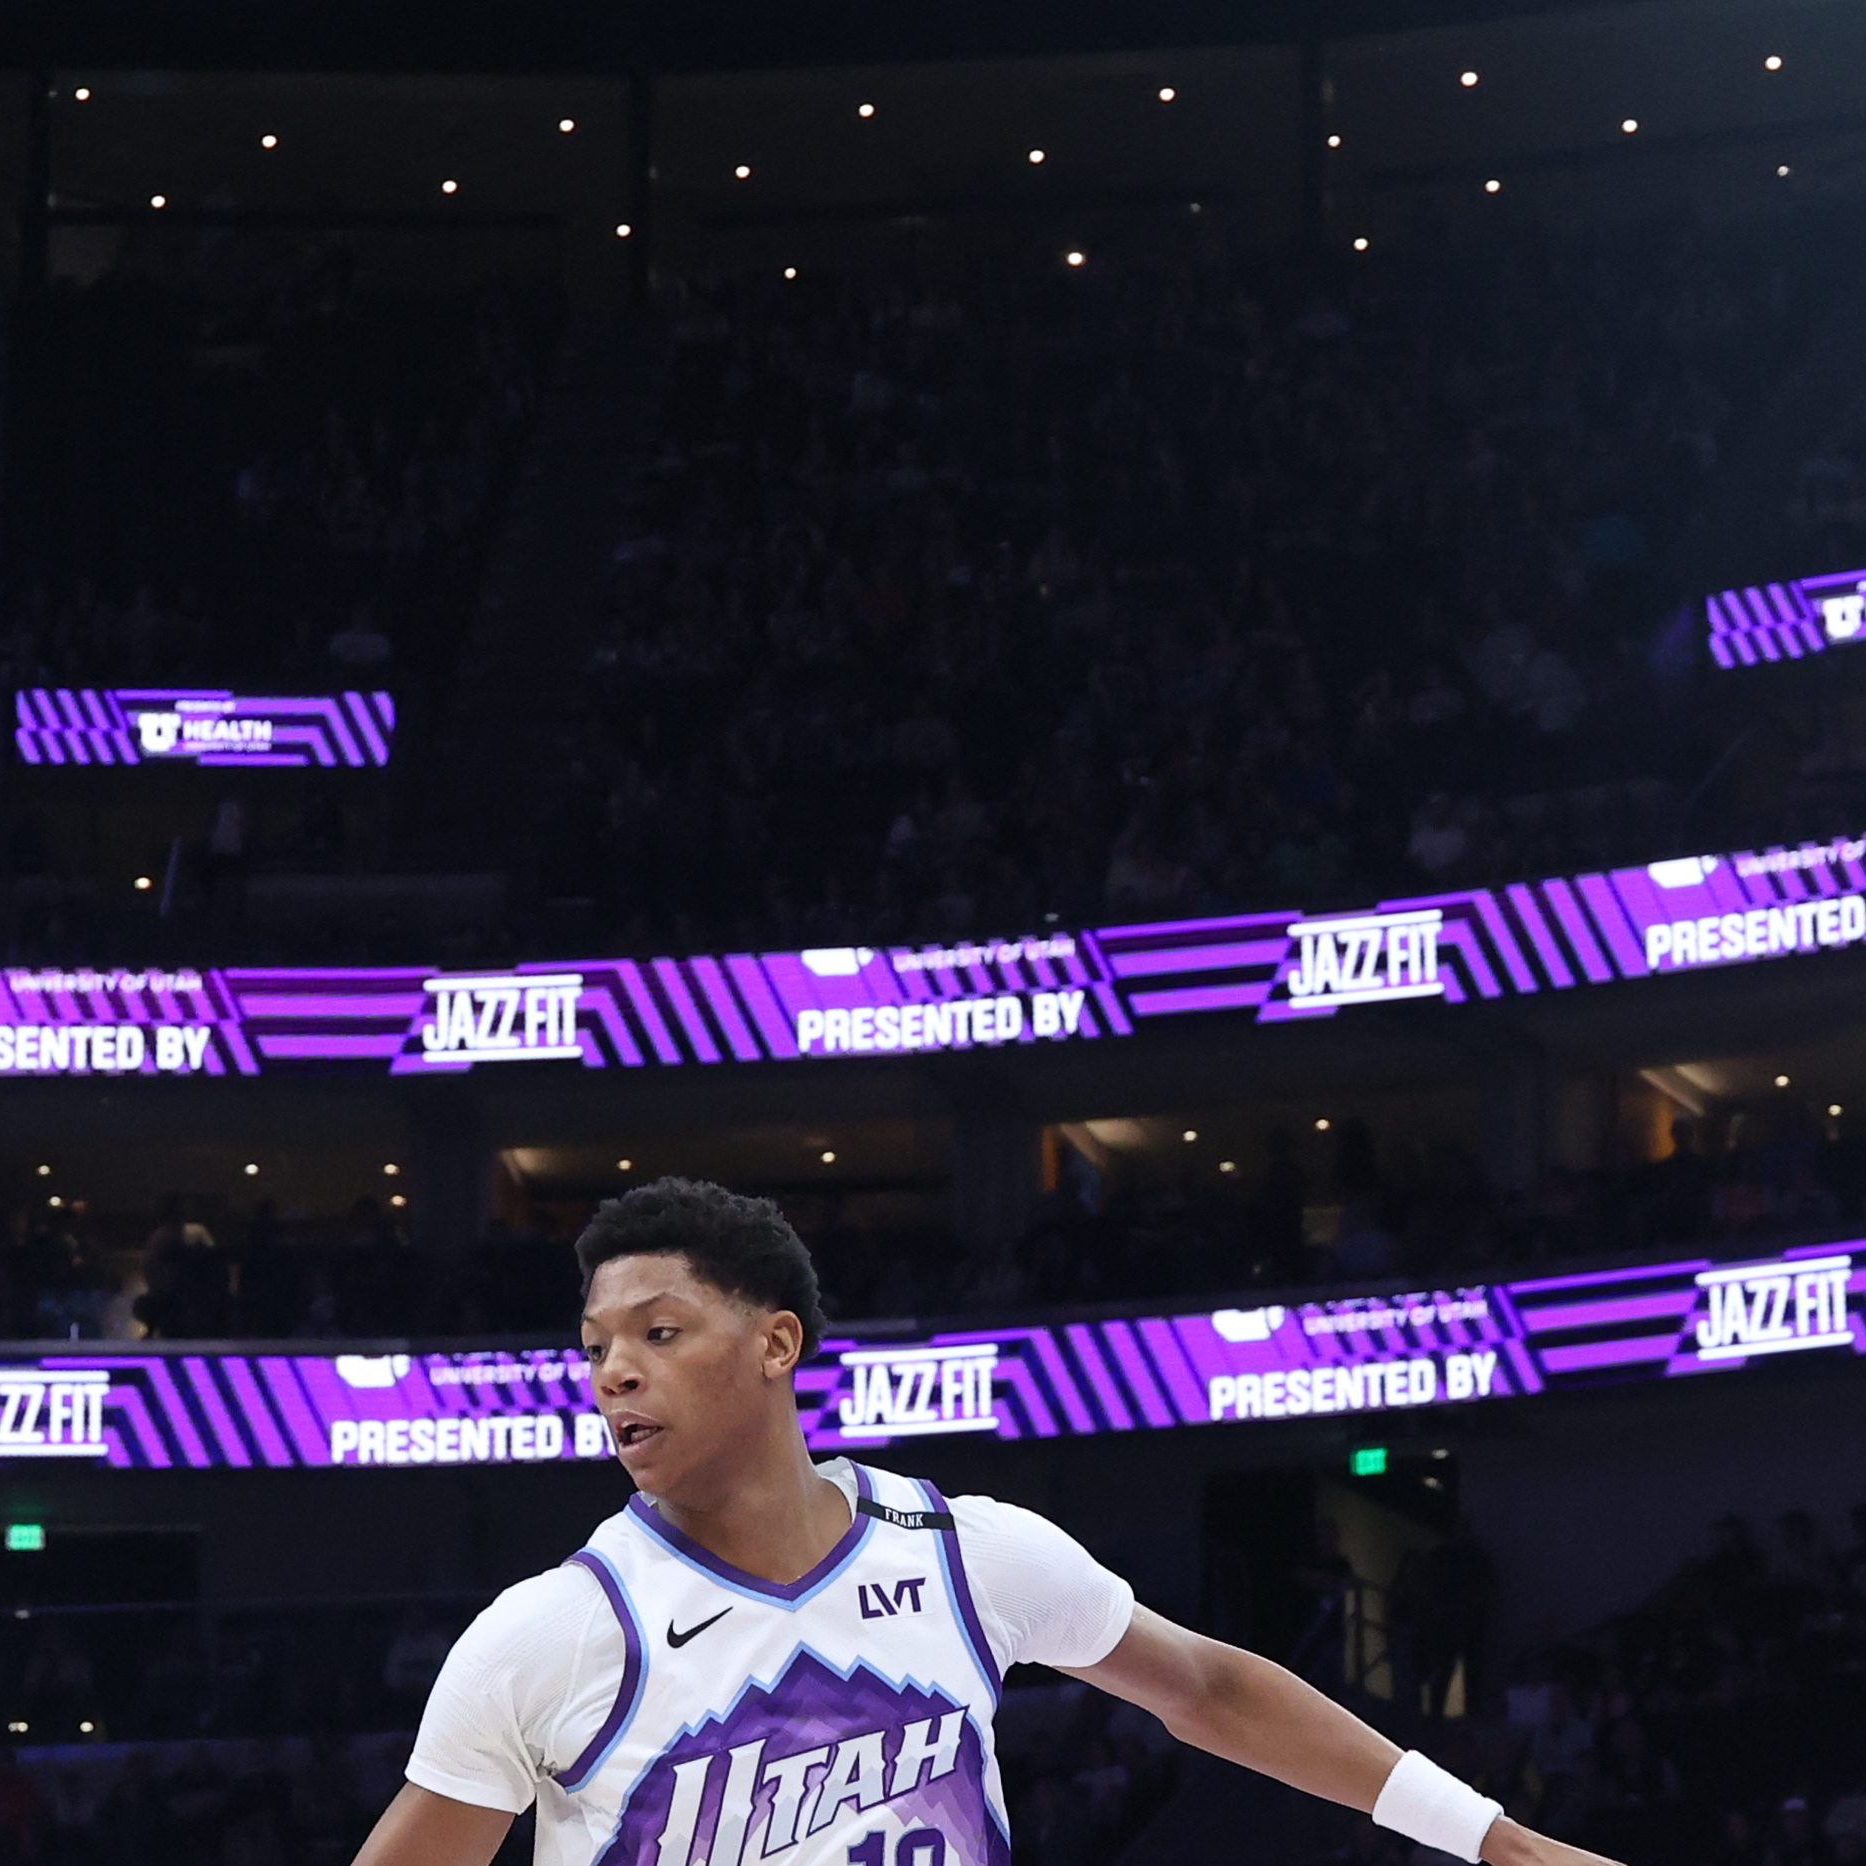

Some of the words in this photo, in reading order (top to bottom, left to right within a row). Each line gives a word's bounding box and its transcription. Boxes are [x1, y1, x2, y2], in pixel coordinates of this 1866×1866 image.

[183, 720, 273, 741] HEALTH
[1287, 925, 1384, 997] JAZZ
[1386, 922, 1442, 986] FIT
[1645, 893, 1866, 970] PRESENTED
[155, 1025, 210, 1071] BY
[422, 988, 524, 1051] JAZZ
[524, 988, 582, 1048] FIT
[797, 994, 1024, 1053] PRESENTED
[1033, 990, 1085, 1036] BY
[1697, 1276, 1794, 1349] JAZZ
[1794, 1268, 1851, 1338] FIT
[49, 1384, 107, 1444] FIT
[840, 1358, 938, 1428] JAZZ
[937, 1354, 997, 1420] FIT
[1208, 1362, 1436, 1421] PRESENTED
[1445, 1350, 1498, 1401] BY
[331, 1417, 564, 1465] PRESENTED
[884, 1508, 924, 1528] FRANK
[857, 1577, 927, 1620] LVT
